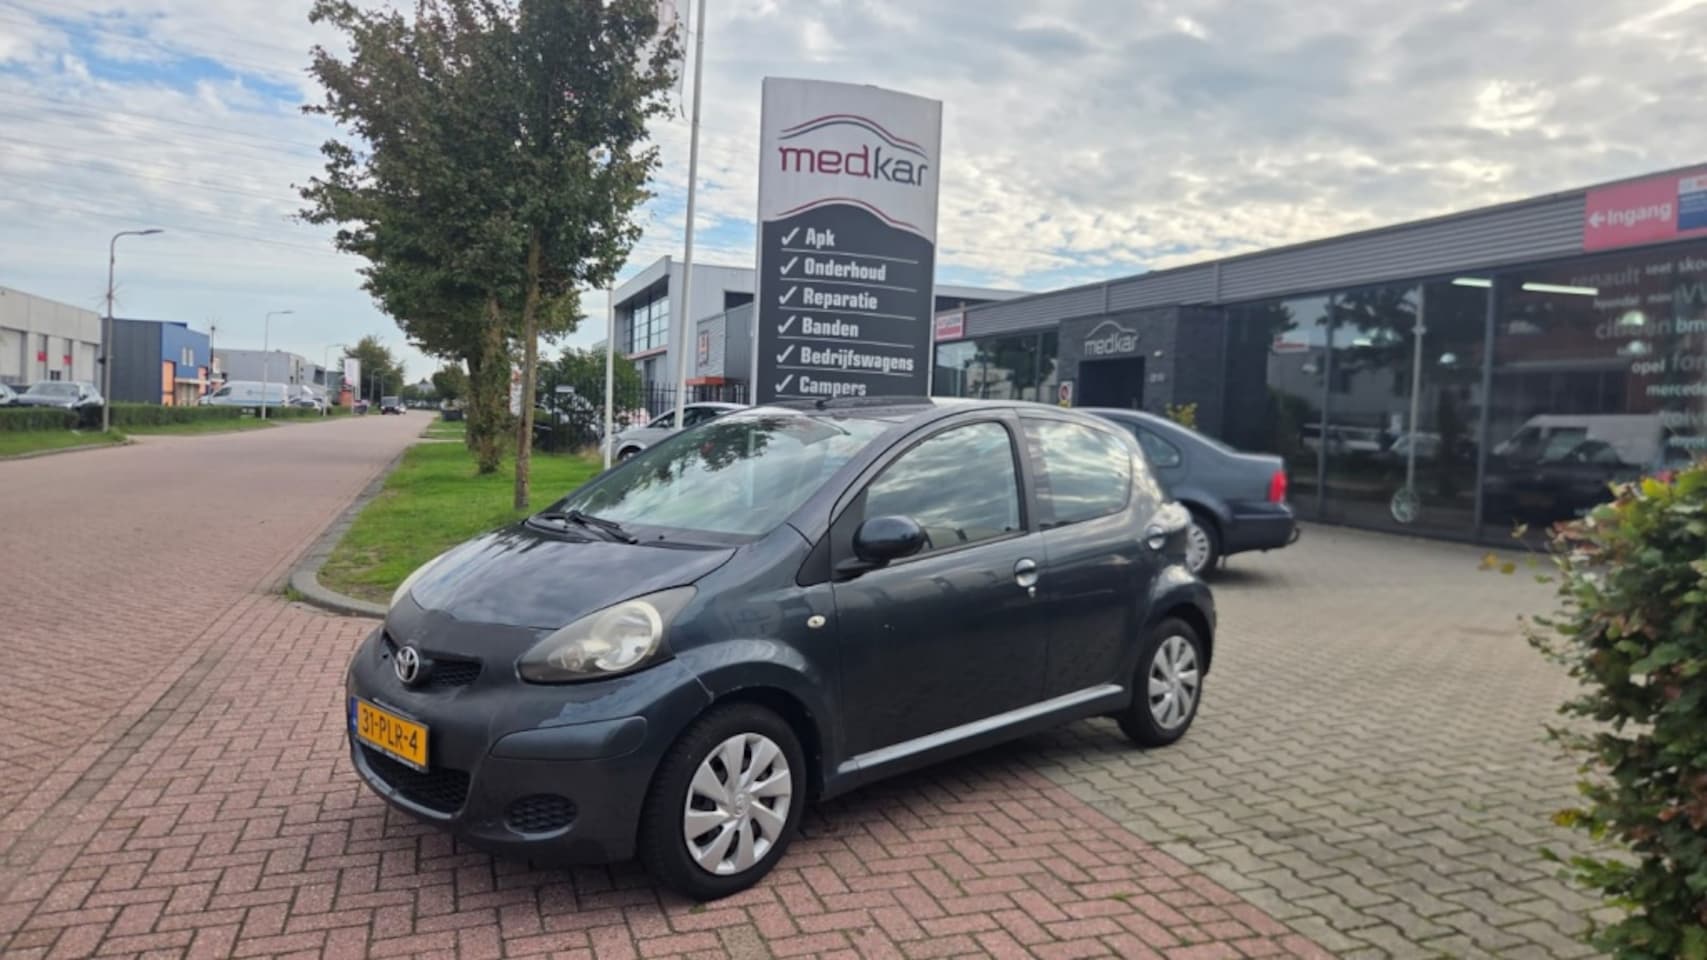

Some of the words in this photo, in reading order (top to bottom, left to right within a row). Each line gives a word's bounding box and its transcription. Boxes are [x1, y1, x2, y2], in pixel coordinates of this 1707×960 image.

[777, 144, 929, 187] medkar
[1607, 202, 1672, 227] Ingang
[805, 227, 836, 249] Apk
[804, 257, 887, 281] Onderhoud
[1678, 257, 1707, 272] sko
[802, 287, 878, 310] Reparatie
[801, 316, 860, 338] Banden
[1676, 316, 1707, 334] bm
[1083, 332, 1139, 355] medkar
[800, 346, 915, 373] Bedrijfswagens
[1631, 359, 1665, 376] opel
[798, 376, 868, 398] Campers
[362, 708, 418, 756] 31-PLR-4
